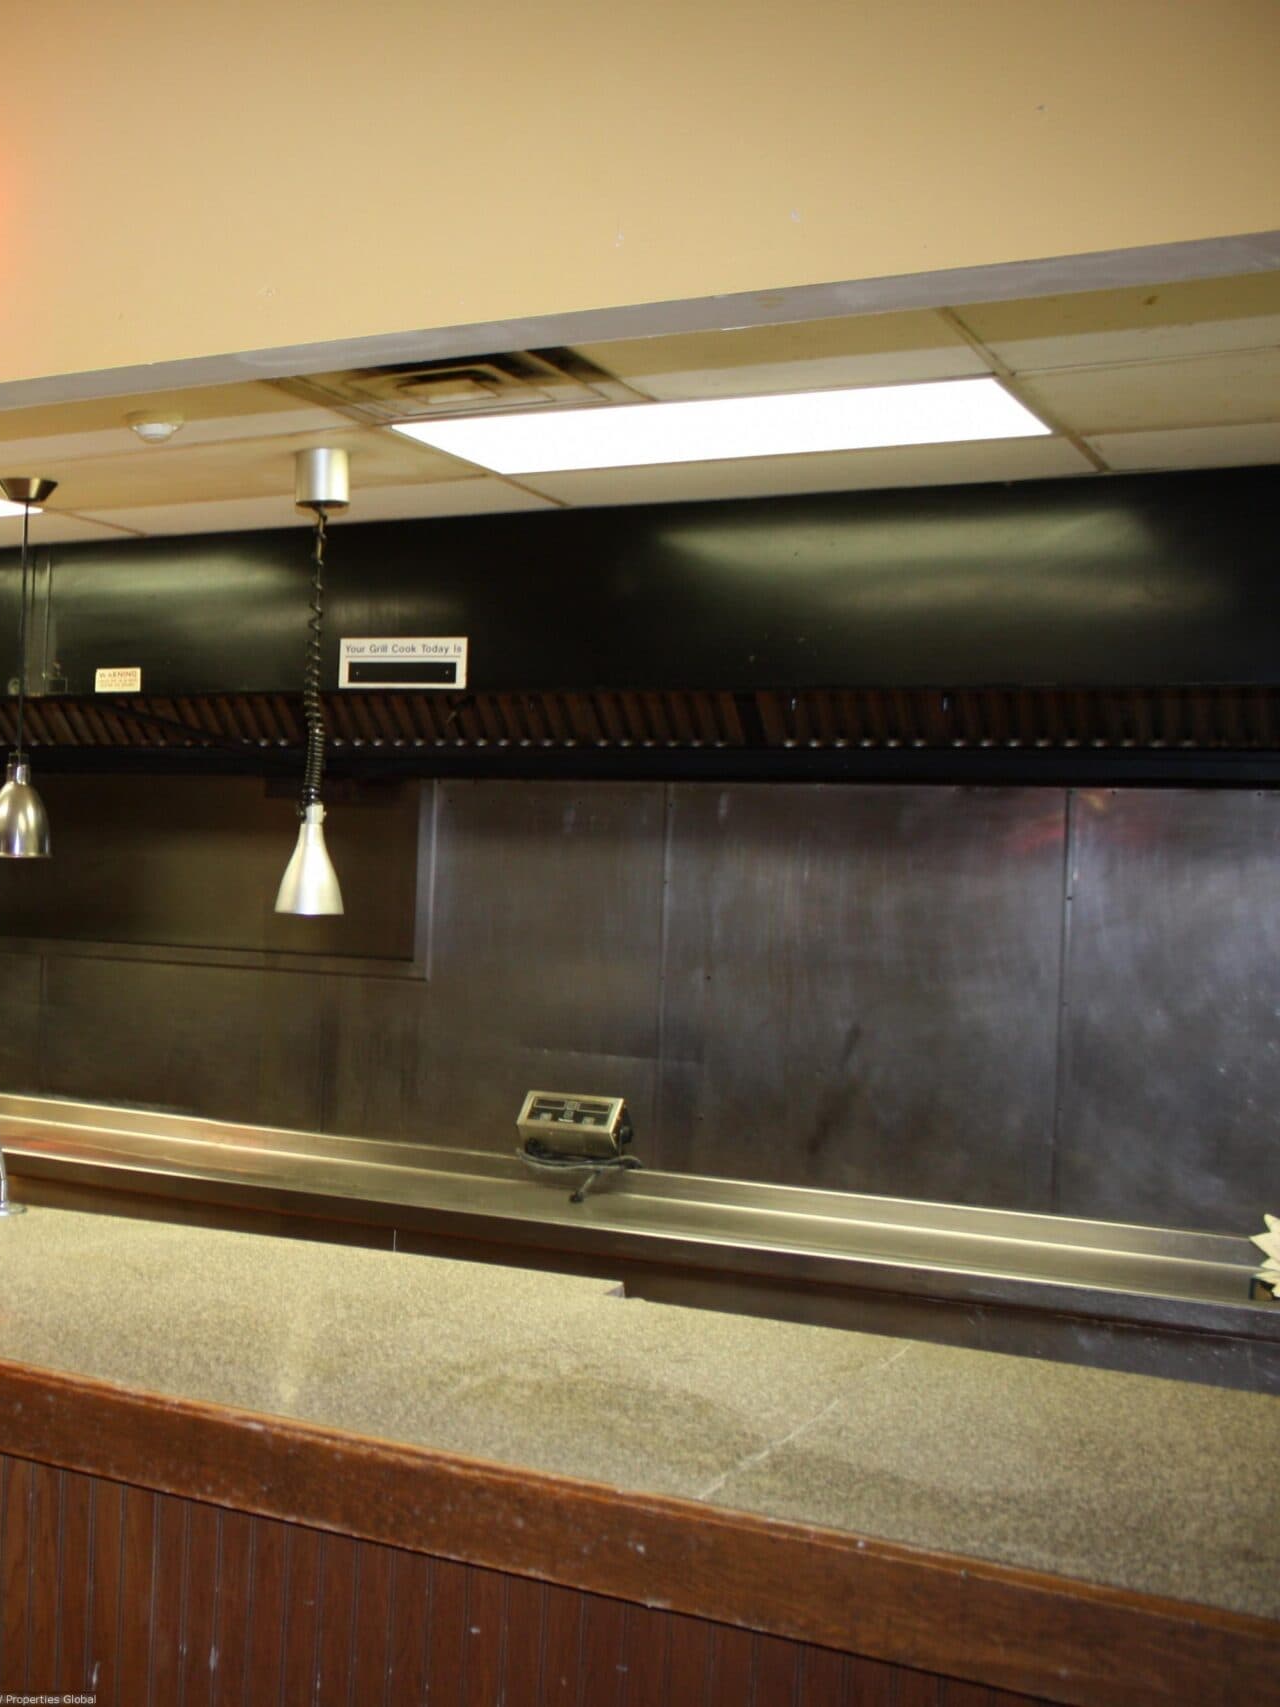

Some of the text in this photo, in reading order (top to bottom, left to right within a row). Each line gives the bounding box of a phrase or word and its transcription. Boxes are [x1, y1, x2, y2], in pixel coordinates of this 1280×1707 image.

[345, 644, 462, 655] Your Grill Cook Today Is
